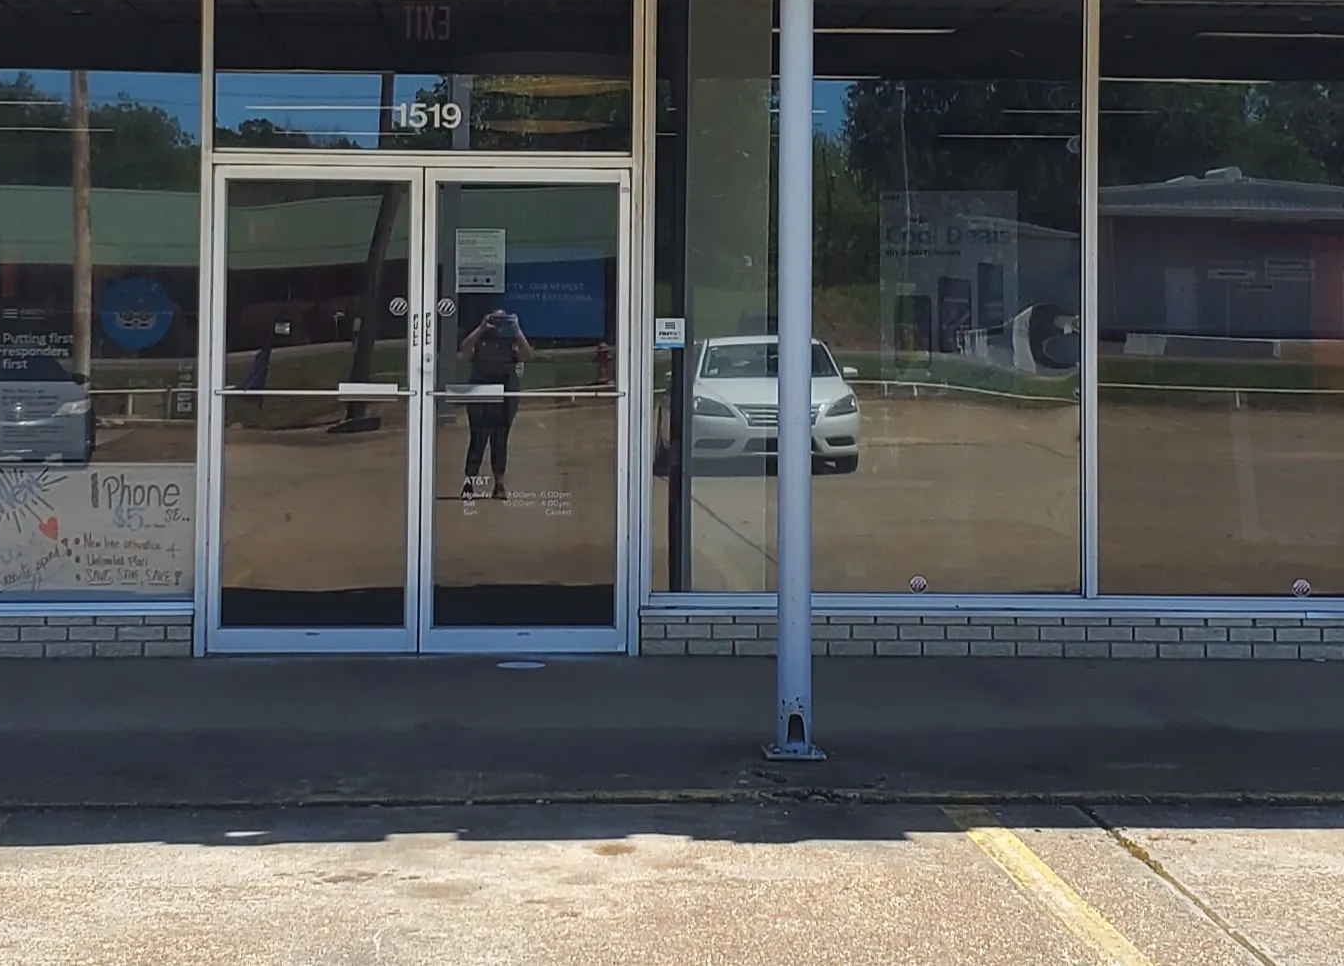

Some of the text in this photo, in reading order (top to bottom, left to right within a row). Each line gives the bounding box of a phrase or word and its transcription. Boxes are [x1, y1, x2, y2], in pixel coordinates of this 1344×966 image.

[396, 102, 463, 129] 1519
[947, 224, 1010, 244] Deals
[3, 332, 74, 346] Putting first
[3, 345, 69, 359] responders
[2, 358, 28, 370] first
[463, 475, 491, 487] AT&T
